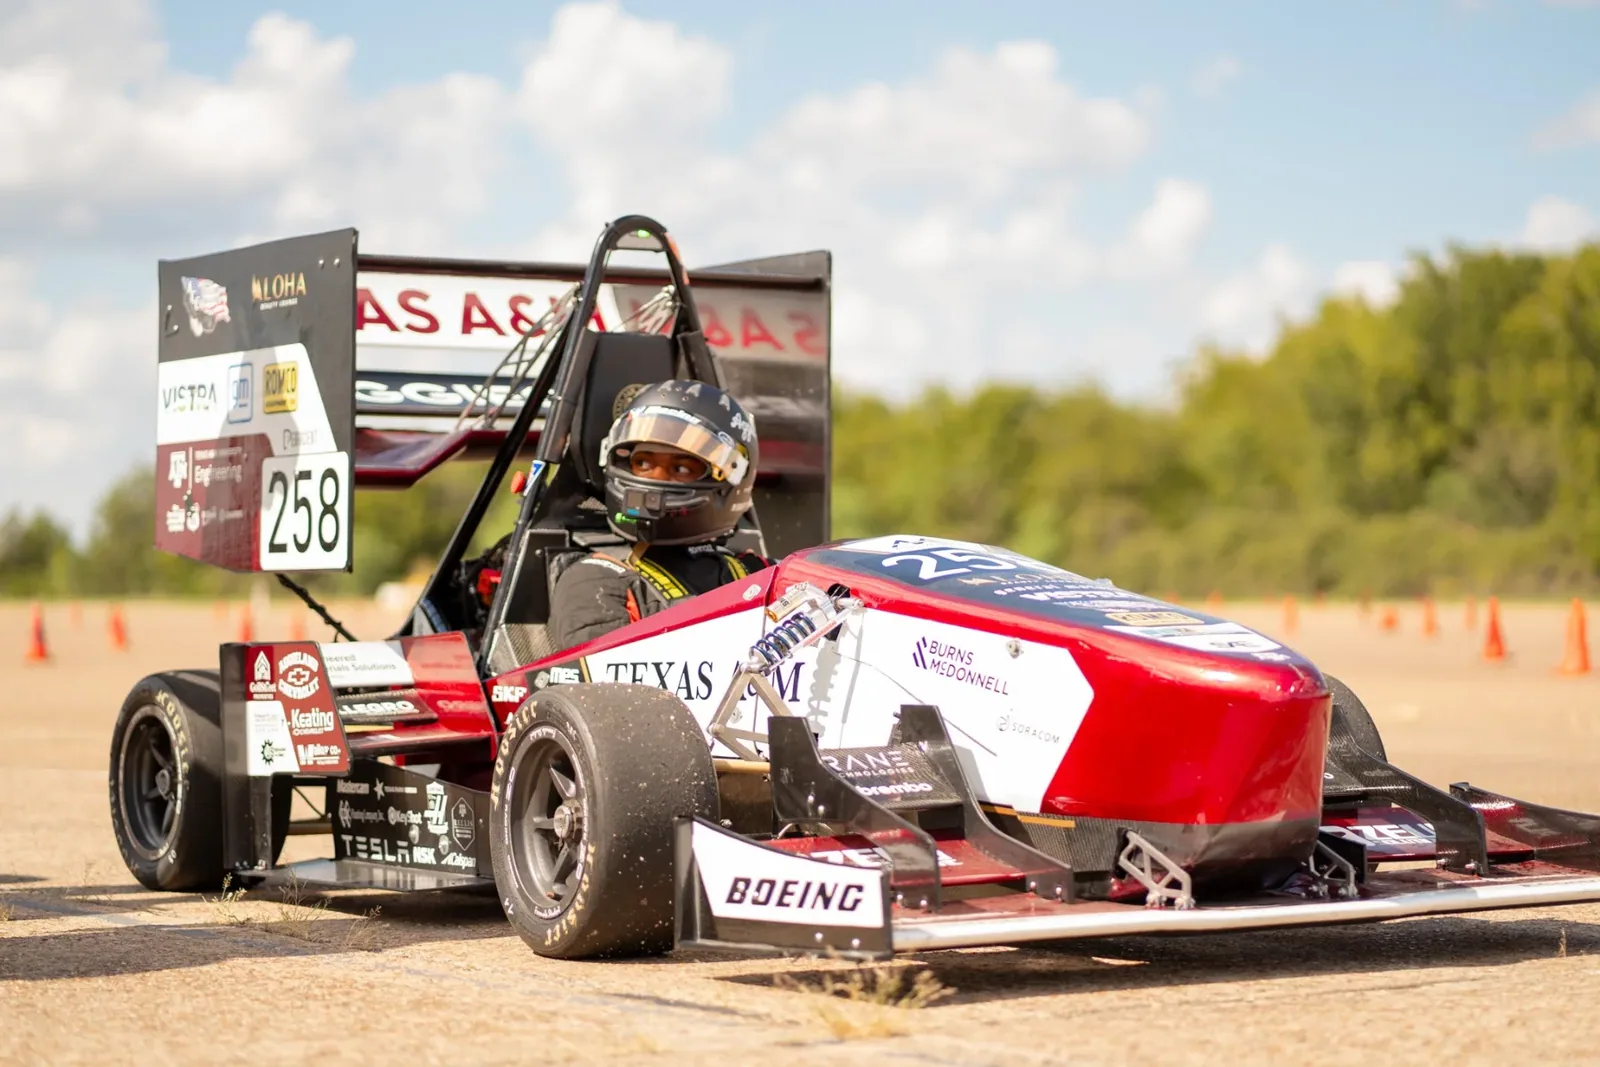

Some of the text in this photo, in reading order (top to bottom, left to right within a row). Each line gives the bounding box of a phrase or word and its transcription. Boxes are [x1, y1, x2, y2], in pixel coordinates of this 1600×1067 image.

[461, 292, 608, 337] A&
[268, 467, 341, 554] 258
[929, 640, 974, 665] BURNS
[491, 685, 528, 703] SKF
[291, 703, 334, 731] Keating
[1012, 722, 1060, 744] SORACOM
[341, 834, 410, 864] TESLA
[413, 846, 437, 865] NSK
[725, 877, 864, 911] BOEING
